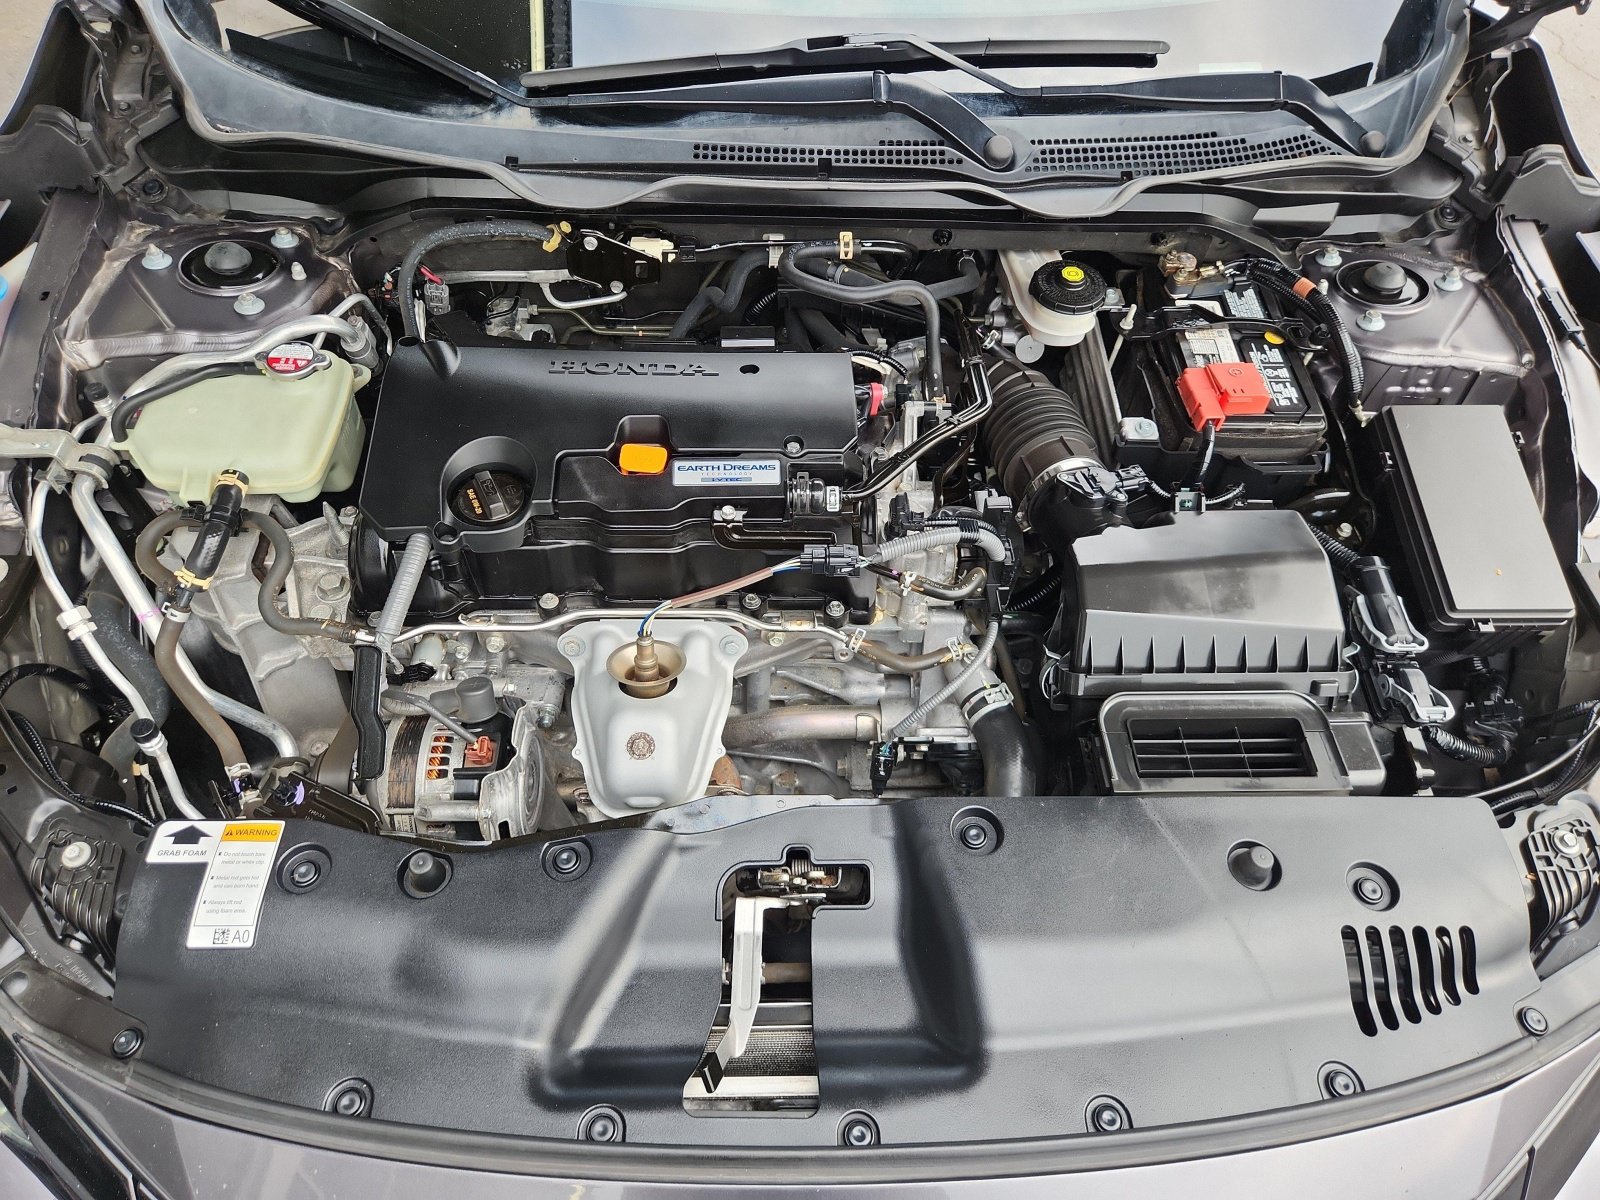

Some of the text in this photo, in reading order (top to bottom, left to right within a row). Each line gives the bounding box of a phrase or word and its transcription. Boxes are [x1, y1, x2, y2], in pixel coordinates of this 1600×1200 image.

[549, 360, 719, 376] HONDA
[677, 463, 777, 472] EARTH DREAMS
[466, 488, 477, 500] SAE
[235, 828, 278, 836] WARNING
[157, 849, 208, 857] GRAB FOAM
[231, 929, 250, 943] A0
